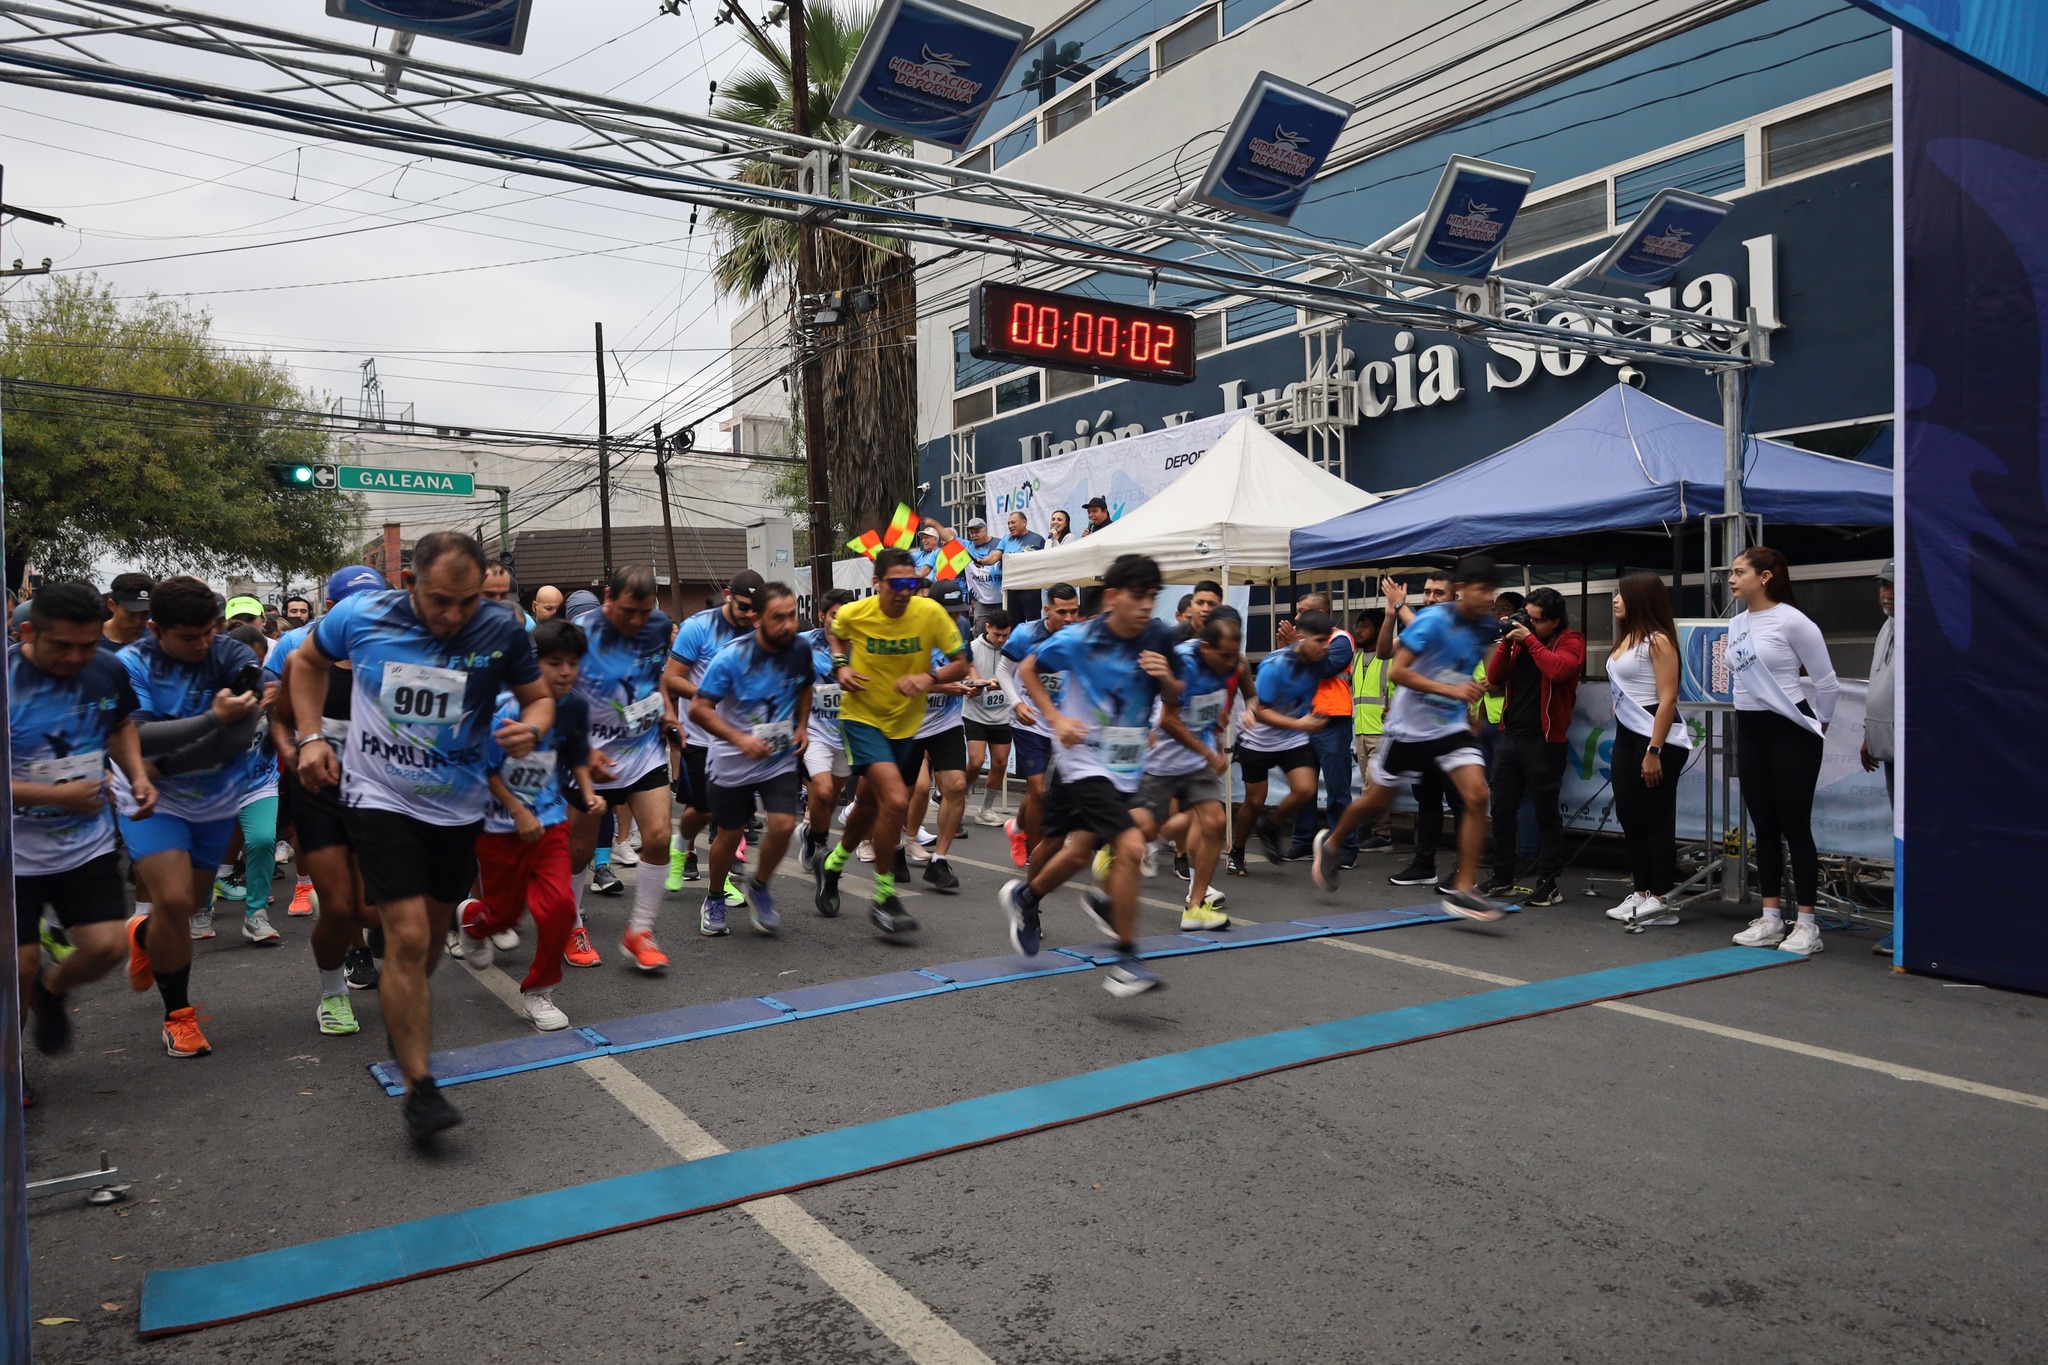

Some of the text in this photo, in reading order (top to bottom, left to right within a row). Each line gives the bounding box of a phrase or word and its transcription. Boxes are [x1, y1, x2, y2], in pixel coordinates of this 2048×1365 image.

[889, 56, 982, 95] HIDRATACION
[895, 71, 972, 104] DEPORTIVA
[1249, 138, 1315, 168] HIDRATACION
[1251, 152, 1306, 178] DEPORTIVA
[1446, 214, 1503, 233] HIDRATACION
[1449, 225, 1496, 242] DEPORTIVA
[1012, 302, 1174, 365] 00:00:02
[359, 472, 454, 490] GALEANA
[867, 636, 923, 655] BRASIL
[1712, 641, 1720, 692] DEPORTIVA
[394, 687, 449, 718] 901
[987, 694, 1005, 706] 829
